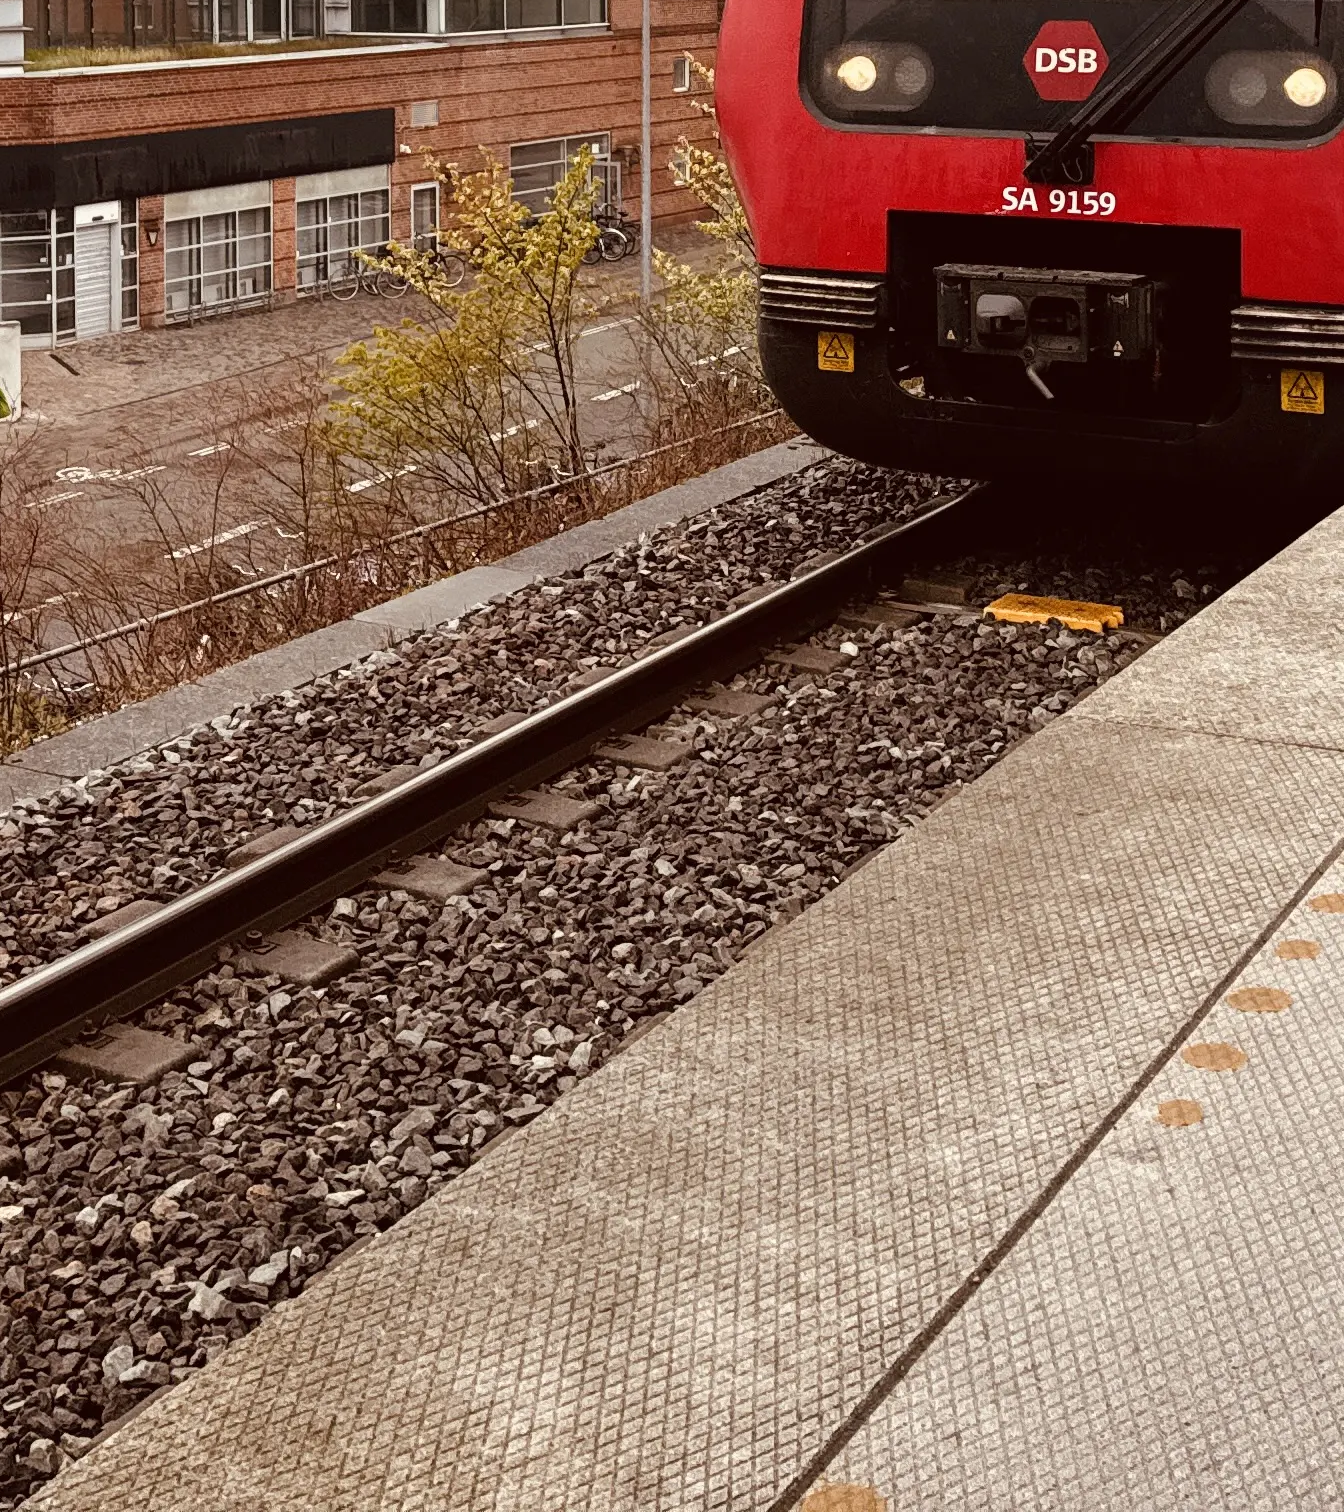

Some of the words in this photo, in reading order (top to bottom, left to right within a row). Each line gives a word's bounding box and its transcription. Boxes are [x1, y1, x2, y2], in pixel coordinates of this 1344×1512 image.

[1034, 47, 1099, 74] DSB
[1001, 186, 1039, 212] SA
[1049, 189, 1116, 216] 9159
